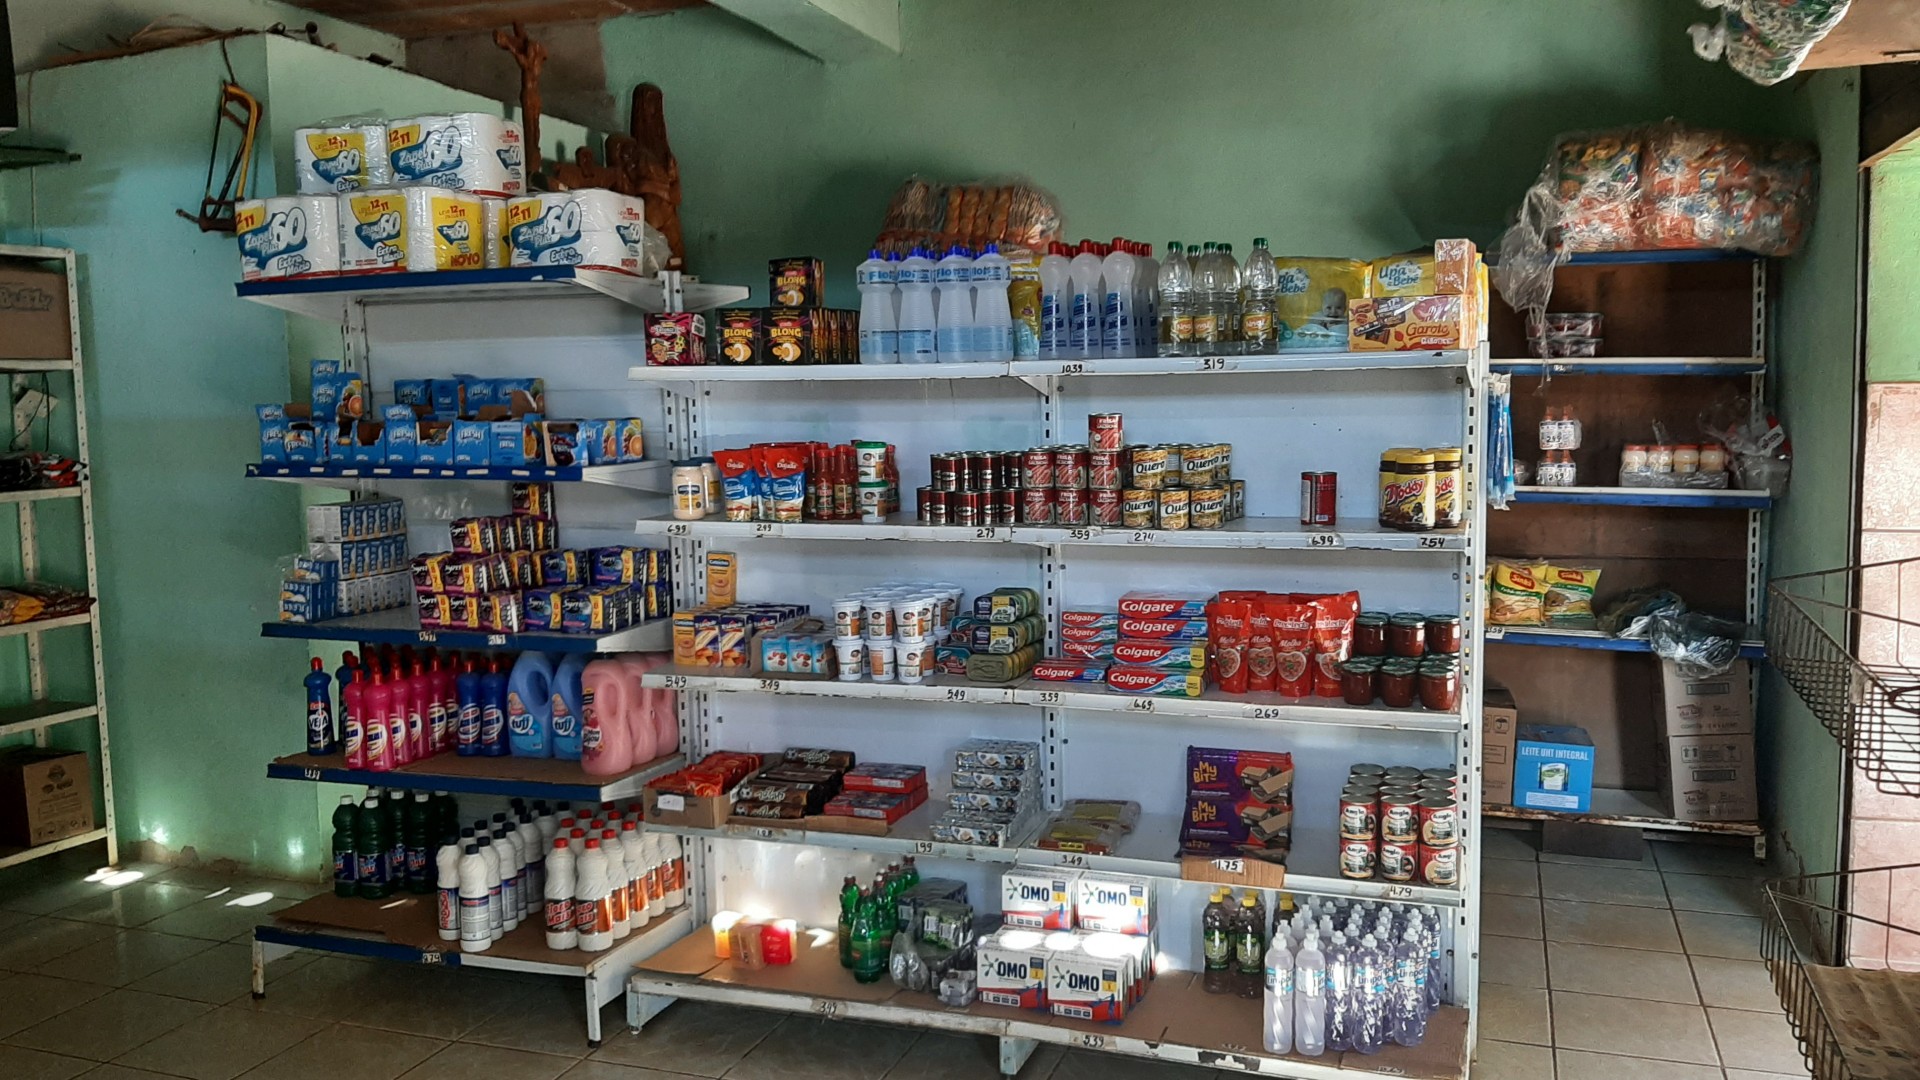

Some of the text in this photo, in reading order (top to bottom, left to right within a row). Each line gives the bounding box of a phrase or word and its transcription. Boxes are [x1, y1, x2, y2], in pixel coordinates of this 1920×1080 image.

[426, 126, 462, 167] 60
[337, 148, 360, 172] 60
[450, 205, 458, 215] 12
[509, 205, 520, 219] 12
[521, 207, 531, 221] 11
[379, 211, 401, 238] 60
[549, 201, 582, 239] 60
[271, 207, 307, 250] 60
[377, 245, 399, 257] Extra
[550, 249, 576, 264] Extra
[277, 254, 303, 270] Extra
[450, 252, 481, 267] NOVO
[776, 276, 807, 286] BLONG
[724, 328, 753, 339] BLONG
[771, 328, 802, 339] BLONG
[1136, 460, 1165, 474] Quero
[1385, 478, 1424, 503] Toddy
[1125, 500, 1154, 513] Quero
[1165, 503, 1189, 515] Quer
[1311, 535, 1334, 546] 6.99
[1420, 537, 1445, 548] 7.54
[1121, 600, 1175, 614] Colgate
[1063, 613, 1096, 623] Colgate
[1062, 627, 1096, 638] Colgate
[1122, 620, 1176, 633] Colgate
[1063, 641, 1097, 652] Colgate
[1116, 645, 1162, 658] Colgate
[1034, 667, 1075, 679] Colgate
[1110, 672, 1157, 685] Colgate
[511, 717, 531, 735] tuff
[554, 717, 573, 735] tuff
[1521, 746, 1540, 757] LEITE
[1555, 749, 1590, 761] INTEGRAL
[1389, 808, 1409, 818] Anglo
[1217, 860, 1239, 871] 1.75
[1021, 884, 1050, 902] OMO
[1098, 889, 1128, 906] OMO
[1390, 885, 1413, 898] 4.79
[997, 961, 1028, 980] OMO
[1068, 973, 1100, 992] OMO
